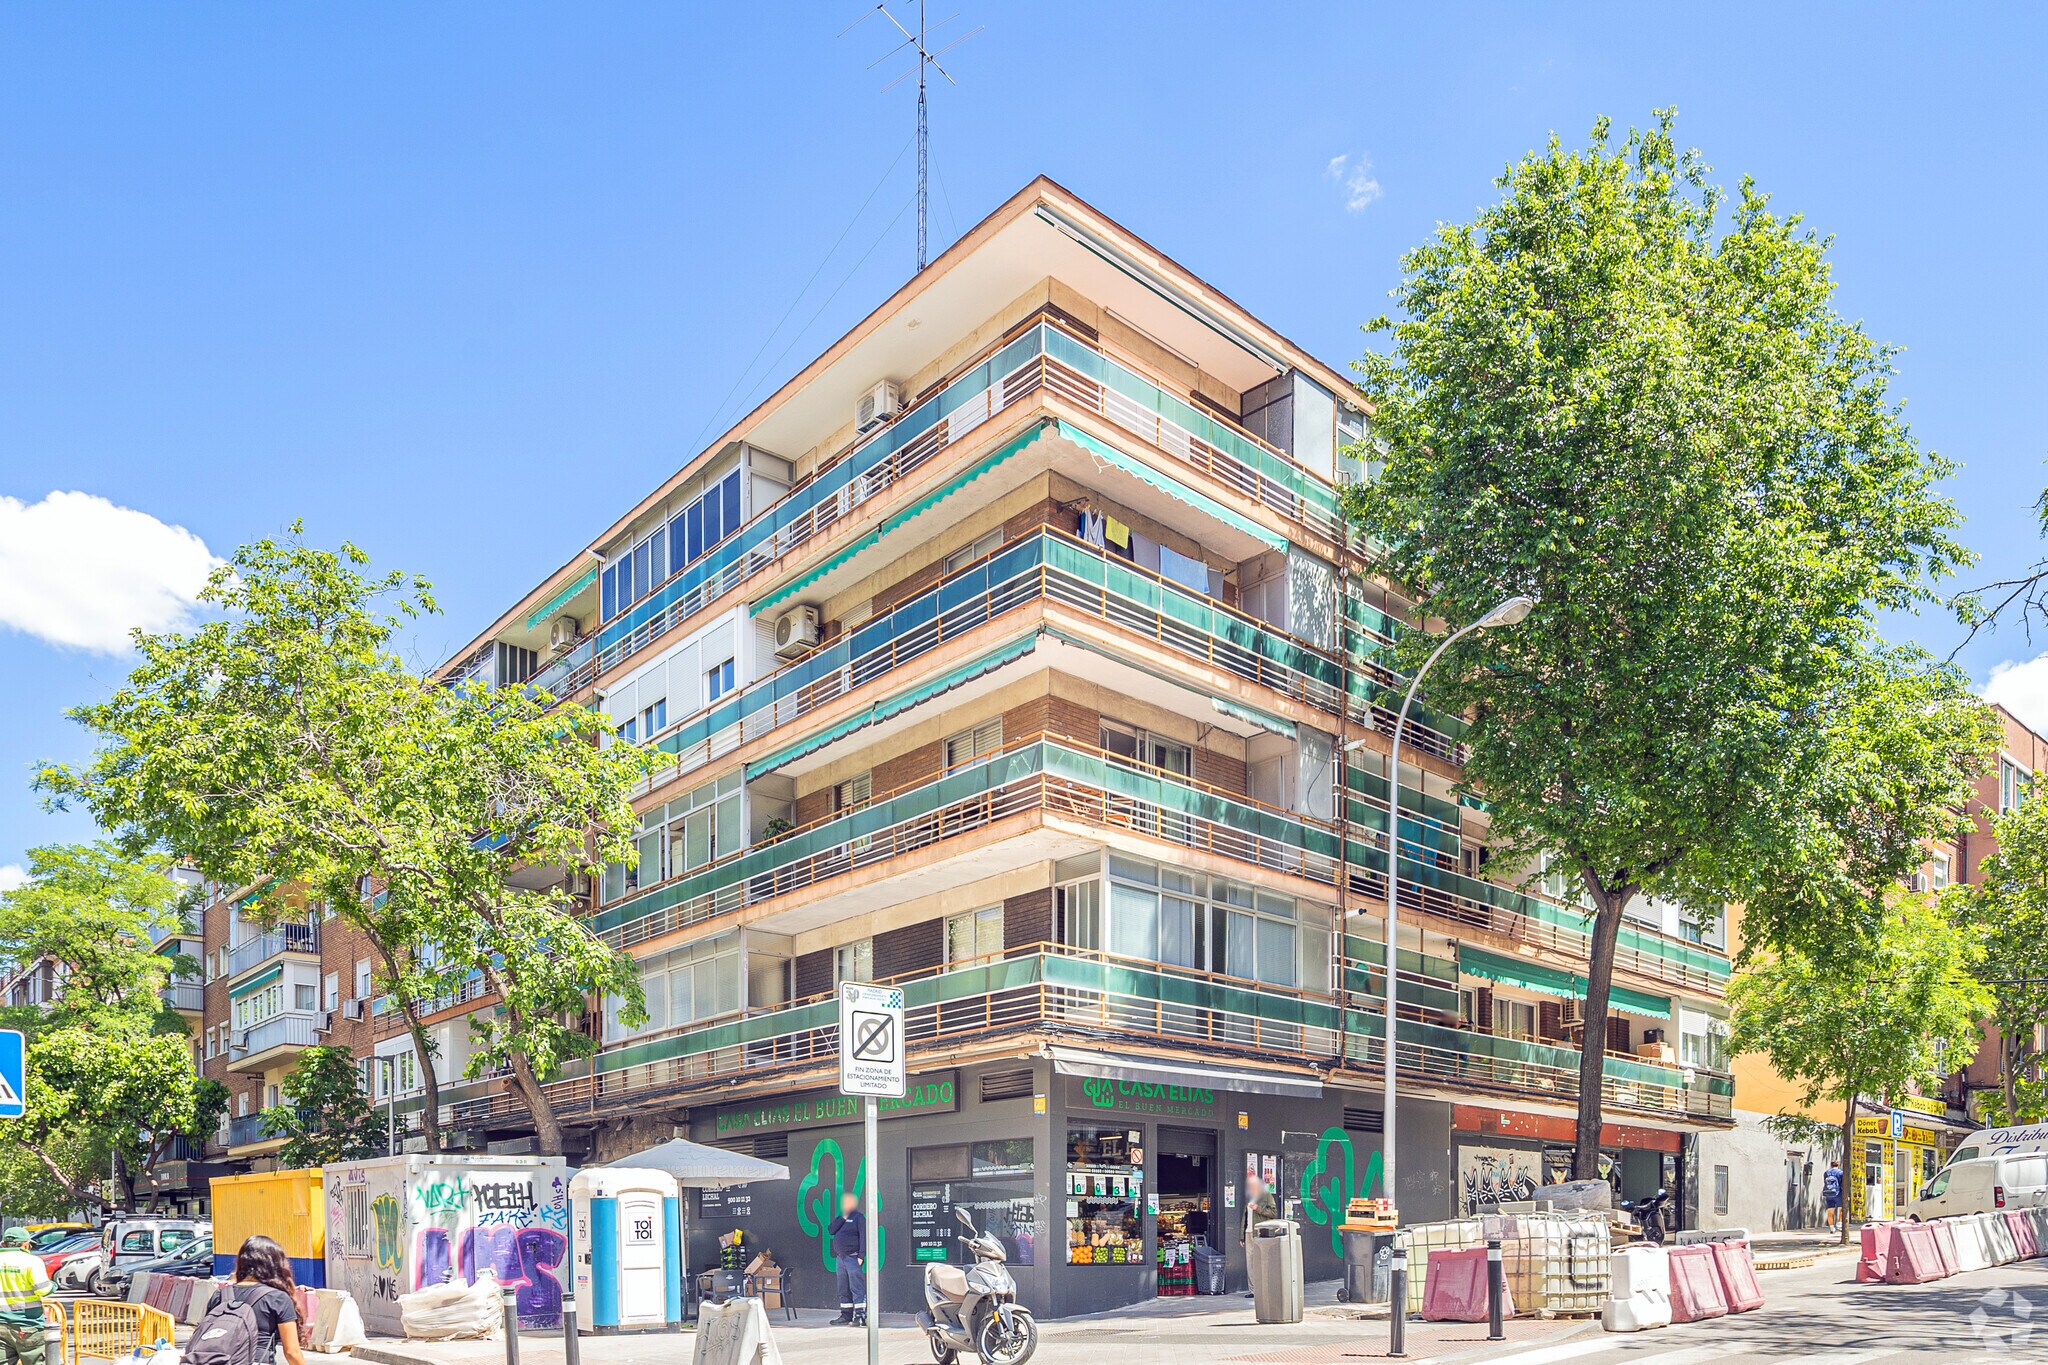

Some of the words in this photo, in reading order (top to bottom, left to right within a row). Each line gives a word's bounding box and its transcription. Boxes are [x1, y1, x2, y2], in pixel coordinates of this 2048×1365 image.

[847, 1073, 900, 1083] ESTACIONAMIENTO
[860, 1081, 887, 1089] LIMITADO
[1118, 1079, 1166, 1099] CASA
[717, 1112, 750, 1131] CASA
[794, 1102, 811, 1122] EL
[815, 1096, 858, 1119] BUEN
[878, 1081, 953, 1111] ERCADO
[1118, 1100, 1130, 1110] EL
[1135, 1102, 1162, 1112] BUEN
[1166, 1106, 1214, 1117] MERCADO
[1857, 1119, 1877, 1127] Döner
[912, 1202, 938, 1211] CORDERO
[912, 1210, 934, 1218] LECHAL
[634, 1230, 652, 1239] TOI
